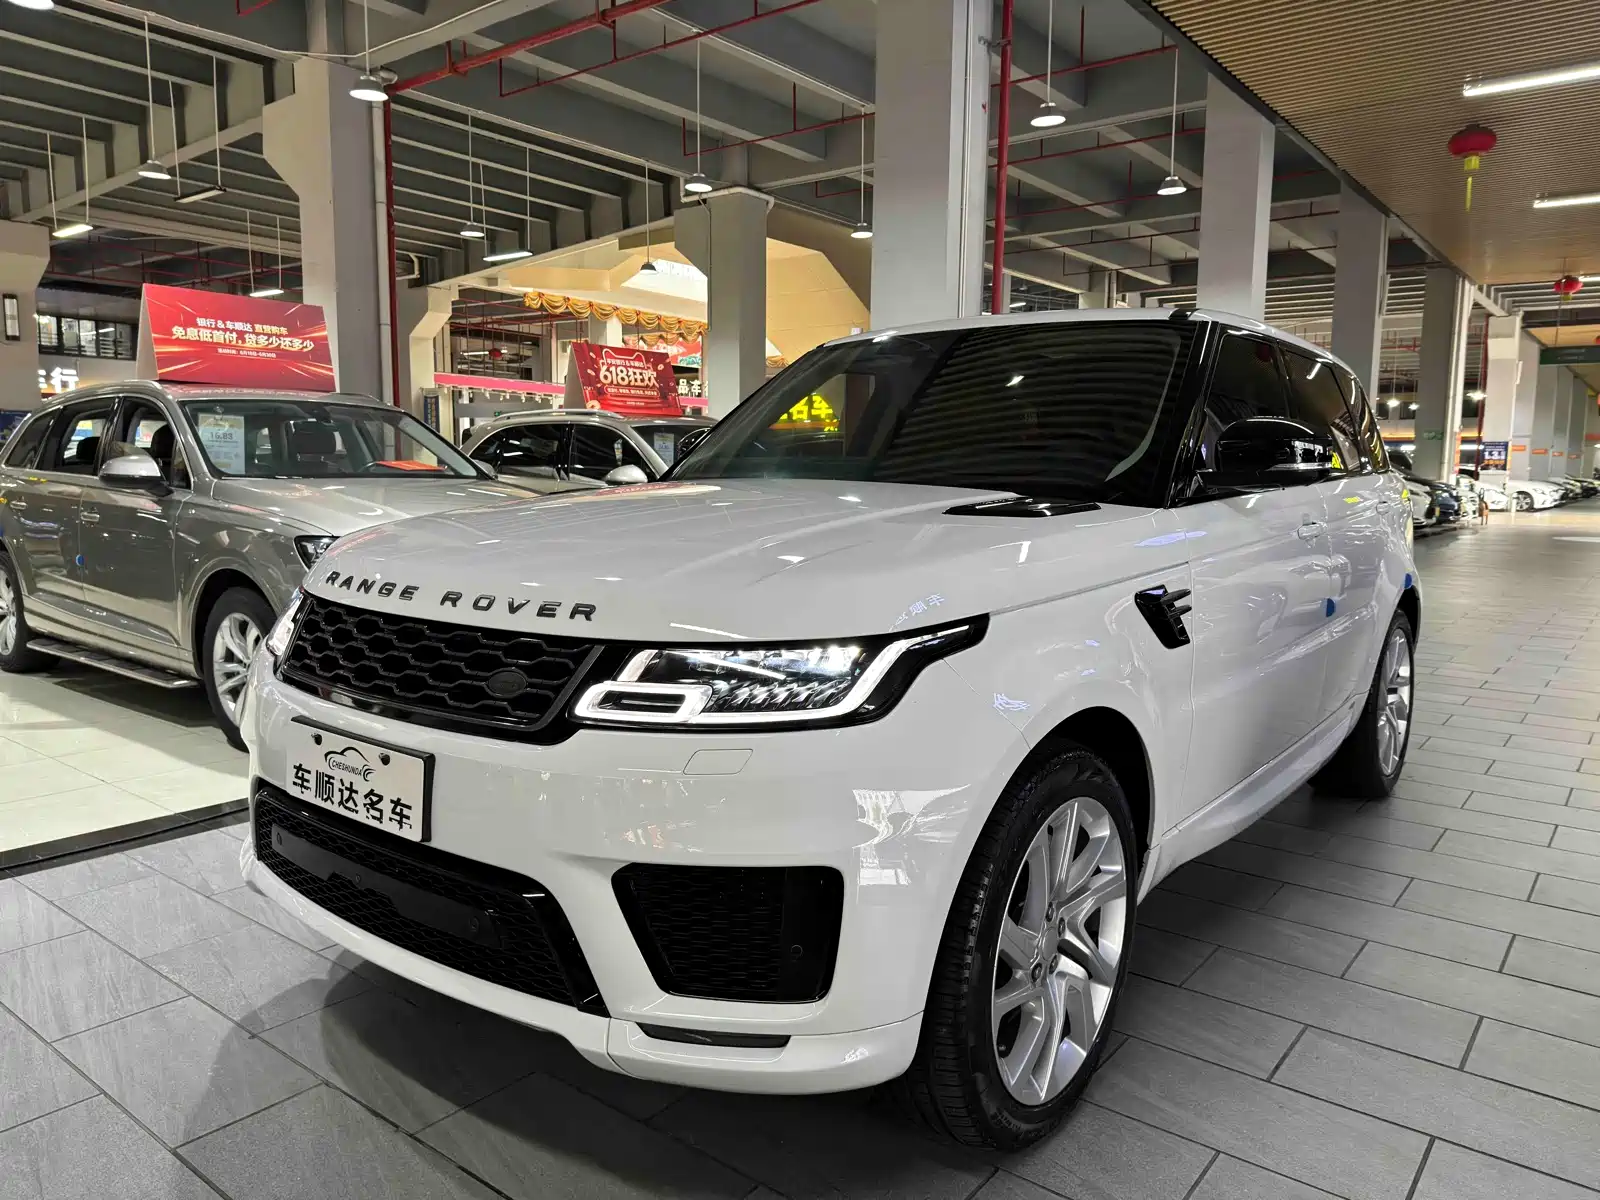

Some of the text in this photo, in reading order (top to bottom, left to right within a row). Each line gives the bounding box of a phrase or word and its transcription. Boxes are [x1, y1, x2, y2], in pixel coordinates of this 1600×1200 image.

[196, 317, 216, 328] 银行
[226, 320, 253, 331] 车顺达
[254, 323, 288, 335] 直营购车
[600, 365, 660, 388] 618狂欢
[780, 395, 834, 420] 名车
[325, 570, 597, 622] RANGE ROVER
[331, 759, 363, 777] CHESHUNDA
[292, 762, 413, 831] 车顺达名车
